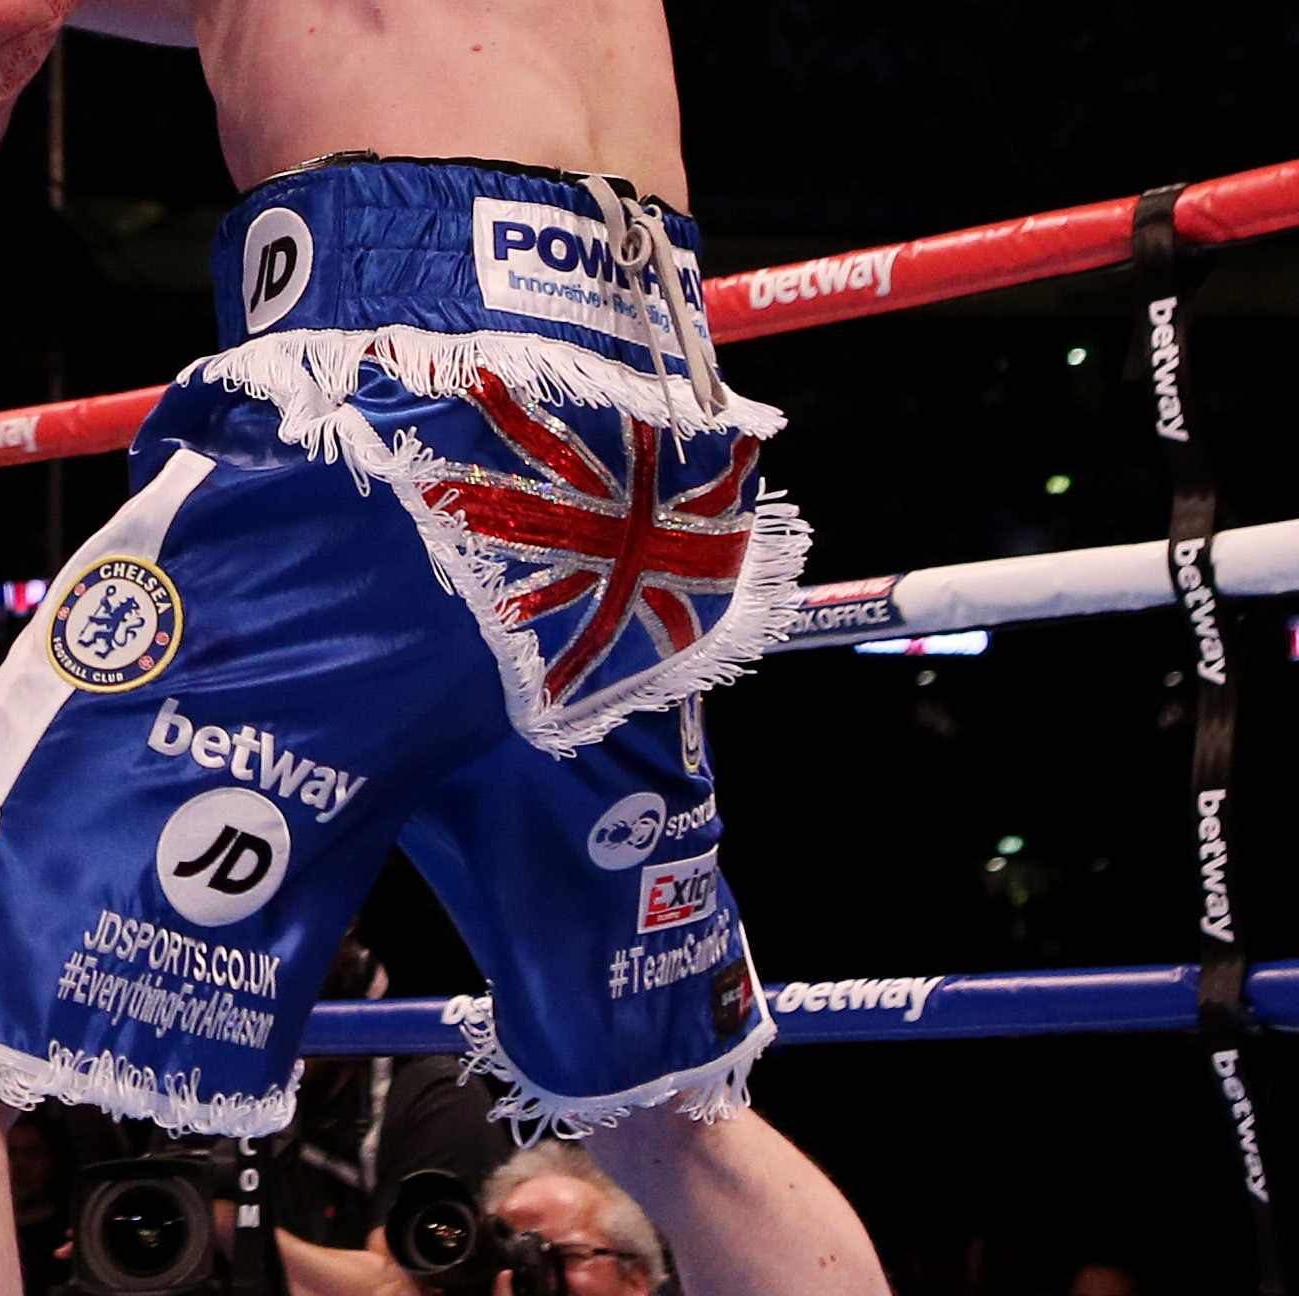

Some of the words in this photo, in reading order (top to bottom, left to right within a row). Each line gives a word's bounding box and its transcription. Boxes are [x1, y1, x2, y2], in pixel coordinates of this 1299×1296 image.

[250, 236, 297, 313] JD
[749, 249, 899, 309] betway
[1150, 297, 1189, 441] betway
[99, 563, 172, 614] CHELSEA
[816, 600, 892, 630] OFFICE
[1175, 537, 1226, 685] betway
[53, 636, 88, 679] FOOTBALL
[92, 672, 124, 683] CLUB
[148, 698, 368, 823] betway
[173, 825, 272, 895] JD
[1198, 789, 1235, 943] betway
[84, 910, 281, 999] JDSPORTS.CO.UK
[58, 951, 274, 1049] #EverythingForAReason
[776, 975, 946, 1022] betway
[1212, 1049, 1269, 1203] betway
